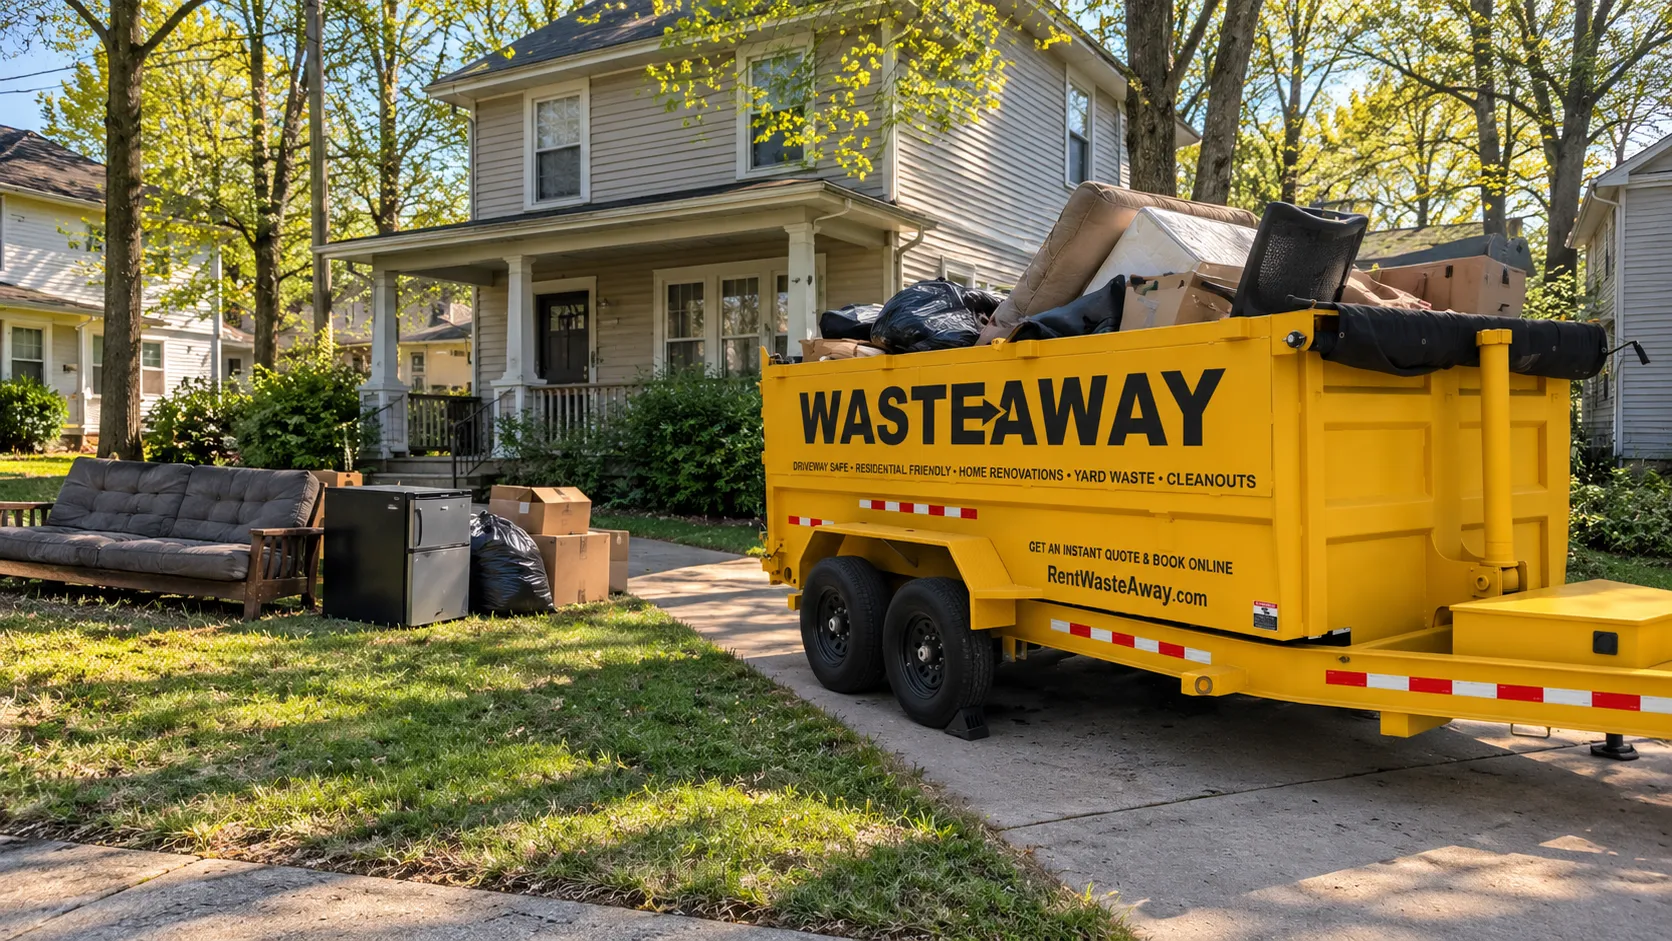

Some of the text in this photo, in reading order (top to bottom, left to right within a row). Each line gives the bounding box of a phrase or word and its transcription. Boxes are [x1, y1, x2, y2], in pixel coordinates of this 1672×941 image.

[792, 461, 1257, 489] DRIVEWAY SAFE RESIDENTIAL FRIENDLY HOME RENOVATIONS YARD WASTE CLEANOUTS
[1028, 541, 1233, 575] GET AN INSTANT QUOTE & BOOK ONLINE
[1047, 564, 1208, 607] RentWasteAway.com
